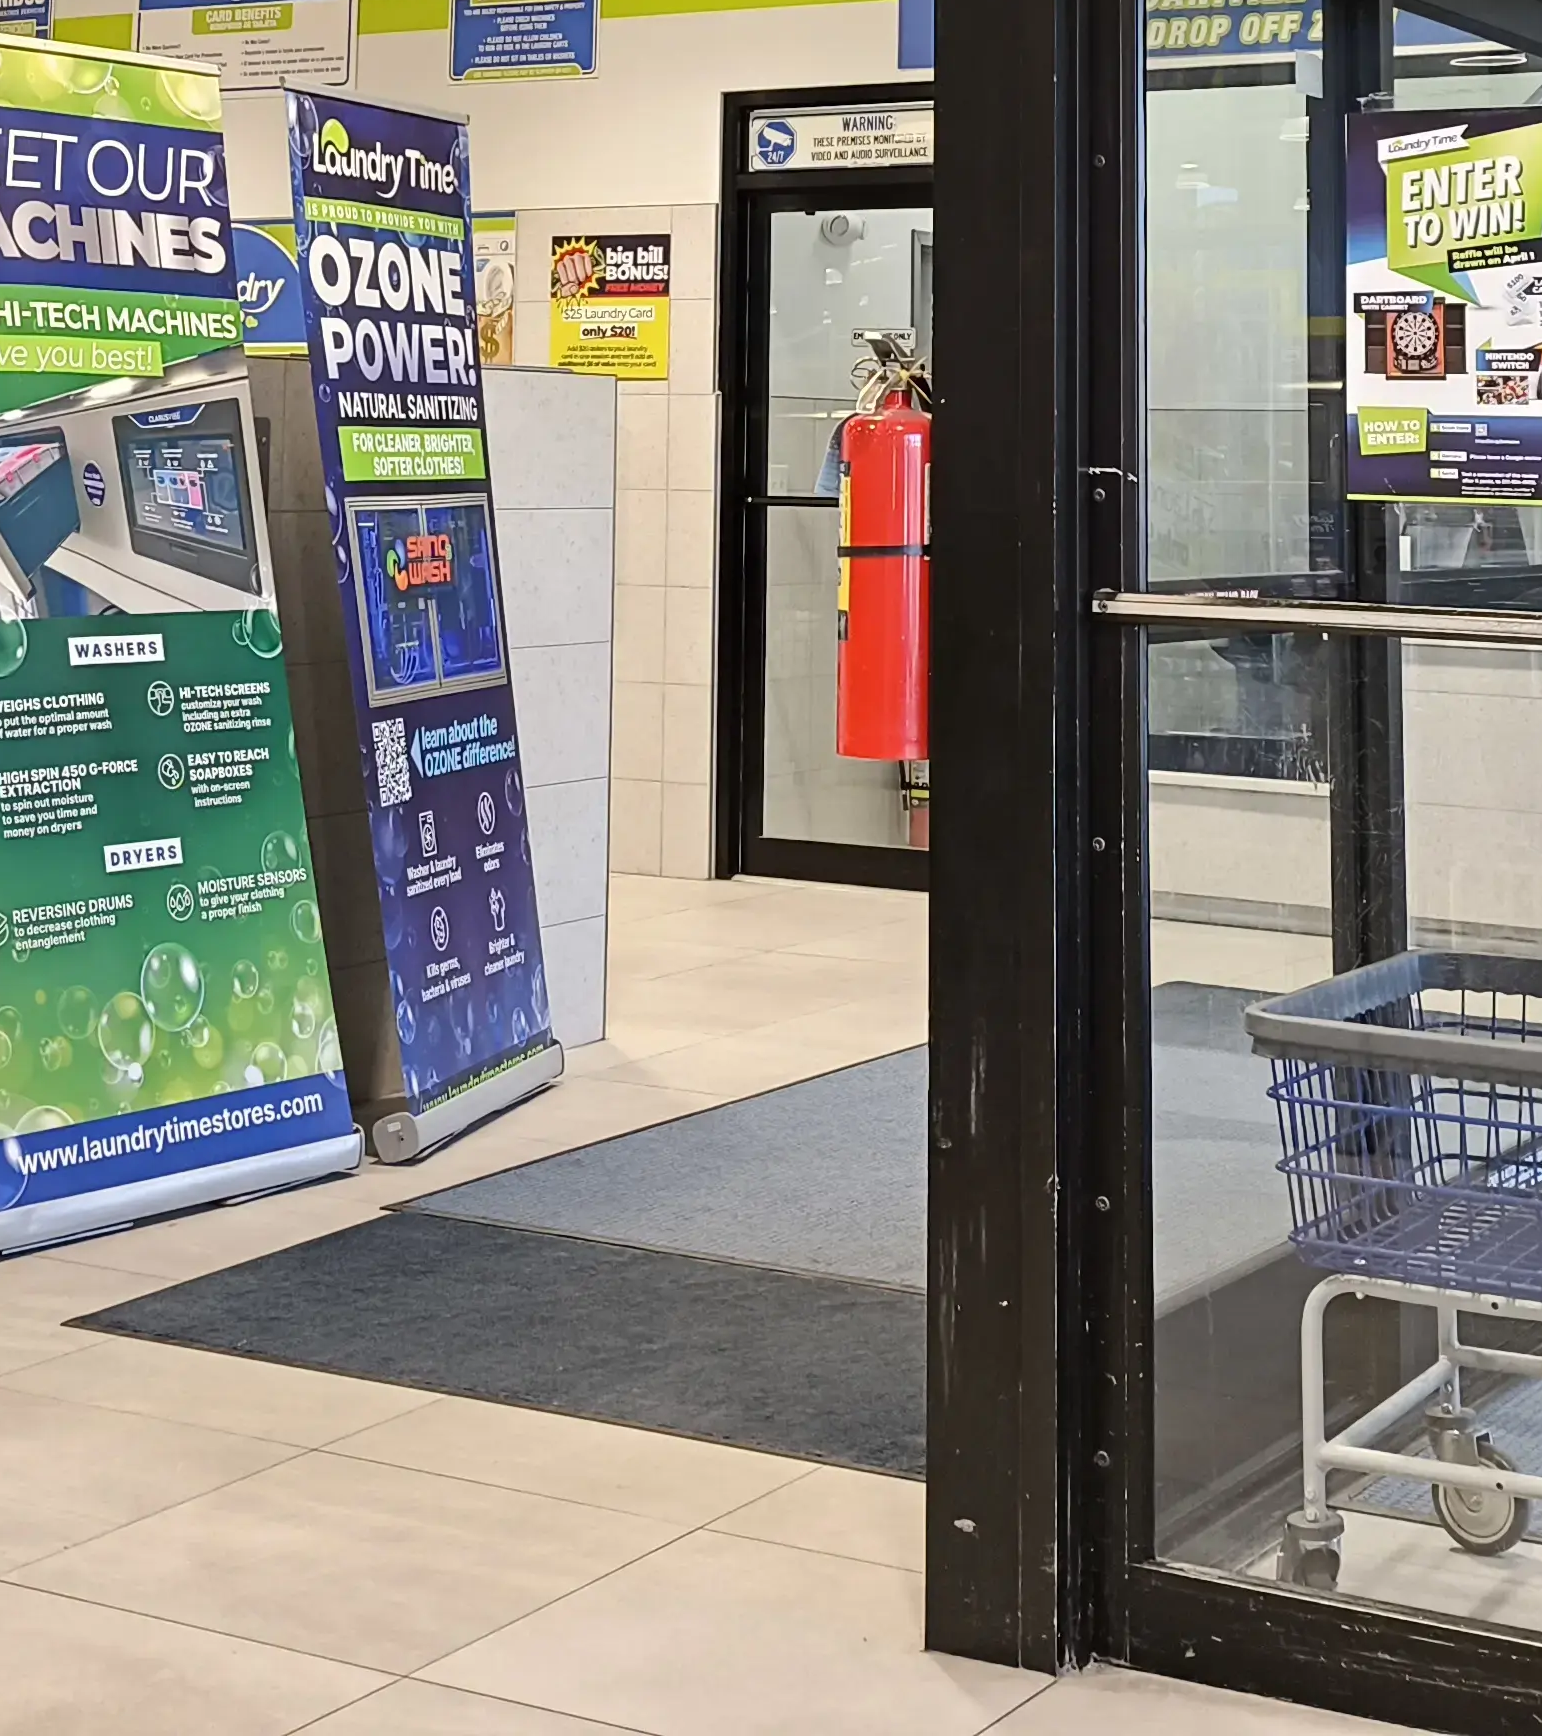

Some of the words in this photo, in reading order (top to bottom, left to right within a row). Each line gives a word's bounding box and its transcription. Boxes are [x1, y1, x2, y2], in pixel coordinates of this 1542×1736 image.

[206, 9, 232, 23] CARD
[235, 6, 281, 21] BENEFITS
[1146, 16, 1231, 49] DROP
[1239, 12, 1303, 45] OFF
[842, 115, 896, 131] WARNING:
[813, 137, 835, 147] THESE
[836, 135, 871, 146] PREMISES
[1387, 138, 1430, 153] Laundry
[1431, 133, 1458, 145] Time
[767, 150, 784, 163] 24/7
[811, 151, 832, 161] VIDEO
[834, 151, 849, 160] AND
[851, 149, 873, 160] AUDIO
[875, 147, 928, 158] SURVEILLANCE
[86, 139, 213, 207] OUR
[312, 132, 404, 199] Laundry
[405, 148, 455, 194] Time
[1401, 155, 1523, 213] ENTER
[307, 202, 318, 215] IS
[322, 204, 358, 220] PROUD
[360, 209, 373, 223] TO
[375, 211, 415, 229] PROVIDE
[418, 217, 436, 231] YOU
[438, 220, 459, 235] WITH
[1403, 212, 1443, 248] TO
[1448, 199, 1525, 242] WIN!
[606, 247, 634, 268] big
[637, 246, 663, 264] bill
[309, 234, 465, 316] OZONE
[605, 265, 669, 281] BONUS!
[1360, 296, 1427, 305] DARTBOARD
[107, 306, 238, 339] MACHINES
[563, 308, 583, 320] $25
[585, 308, 627, 321] Laundry
[629, 308, 653, 318] Card
[582, 326, 608, 340] only
[610, 326, 635, 337] $20!
[34, 349, 83, 373] you
[91, 343, 153, 370] best!
[320, 317, 477, 387] POWER!
[1485, 353, 1534, 361] NINTENDO
[338, 391, 407, 419] NATURAL
[407, 393, 478, 421] SANITIZING
[1364, 422, 1398, 433] HOW
[1402, 421, 1420, 430] TO
[352, 432, 374, 452] FOR
[375, 433, 424, 456] CLEANER,
[424, 433, 475, 455] BRIGHTER,
[1367, 434, 1420, 445] ENTER:
[374, 456, 413, 476] SOFTER
[414, 456, 465, 475] CLOTHES!
[409, 561, 451, 584] WASH
[75, 641, 158, 658] WASHERS
[43, 692, 104, 709] CLOTHING
[179, 684, 223, 699] HI-TECH
[225, 682, 271, 695] SCREENS
[3, 717, 20, 728] put
[21, 715, 37, 725] the
[39, 710, 74, 725] optimal
[76, 708, 109, 720] amount
[5, 727, 32, 738] water
[33, 725, 47, 736] for
[57, 722, 88, 736] proper
[89, 720, 112, 730] wash
[421, 726, 449, 750] learn
[449, 719, 479, 745] about
[479, 714, 498, 737] the
[187, 752, 216, 766] EASY
[218, 752, 232, 763] TO
[233, 748, 269, 762] REACH
[425, 746, 462, 777] OZONE
[462, 735, 516, 769] difference!
[31, 767, 59, 782] SPIN
[62, 764, 87, 778] 450
[89, 759, 138, 775] G-FORCE
[189, 765, 253, 781] SOAPBOXES
[0, 778, 81, 798] EXTRACTION
[1, 802, 11, 812] to
[12, 799, 33, 813] spin
[34, 798, 50, 809] out
[52, 794, 94, 805] moisture
[2, 815, 12, 825] to
[14, 813, 36, 823] save
[37, 811, 56, 823] you
[57, 808, 78, 818] time
[80, 805, 97, 816] and
[3, 827, 35, 839] money
[37, 825, 49, 834] on
[51, 820, 83, 834] dryers
[110, 846, 178, 866] DRYERS
[197, 875, 256, 895] MOISTURE
[257, 868, 307, 887] SENSORS
[12, 901, 86, 924] REVERSING
[89, 894, 133, 913] DRUMS
[14, 927, 25, 937] to
[26, 921, 73, 936] decrease
[74, 913, 116, 927] clothing
[16, 931, 86, 951] entanglement
[17, 1090, 324, 1176] www.laundrytimestores.com
